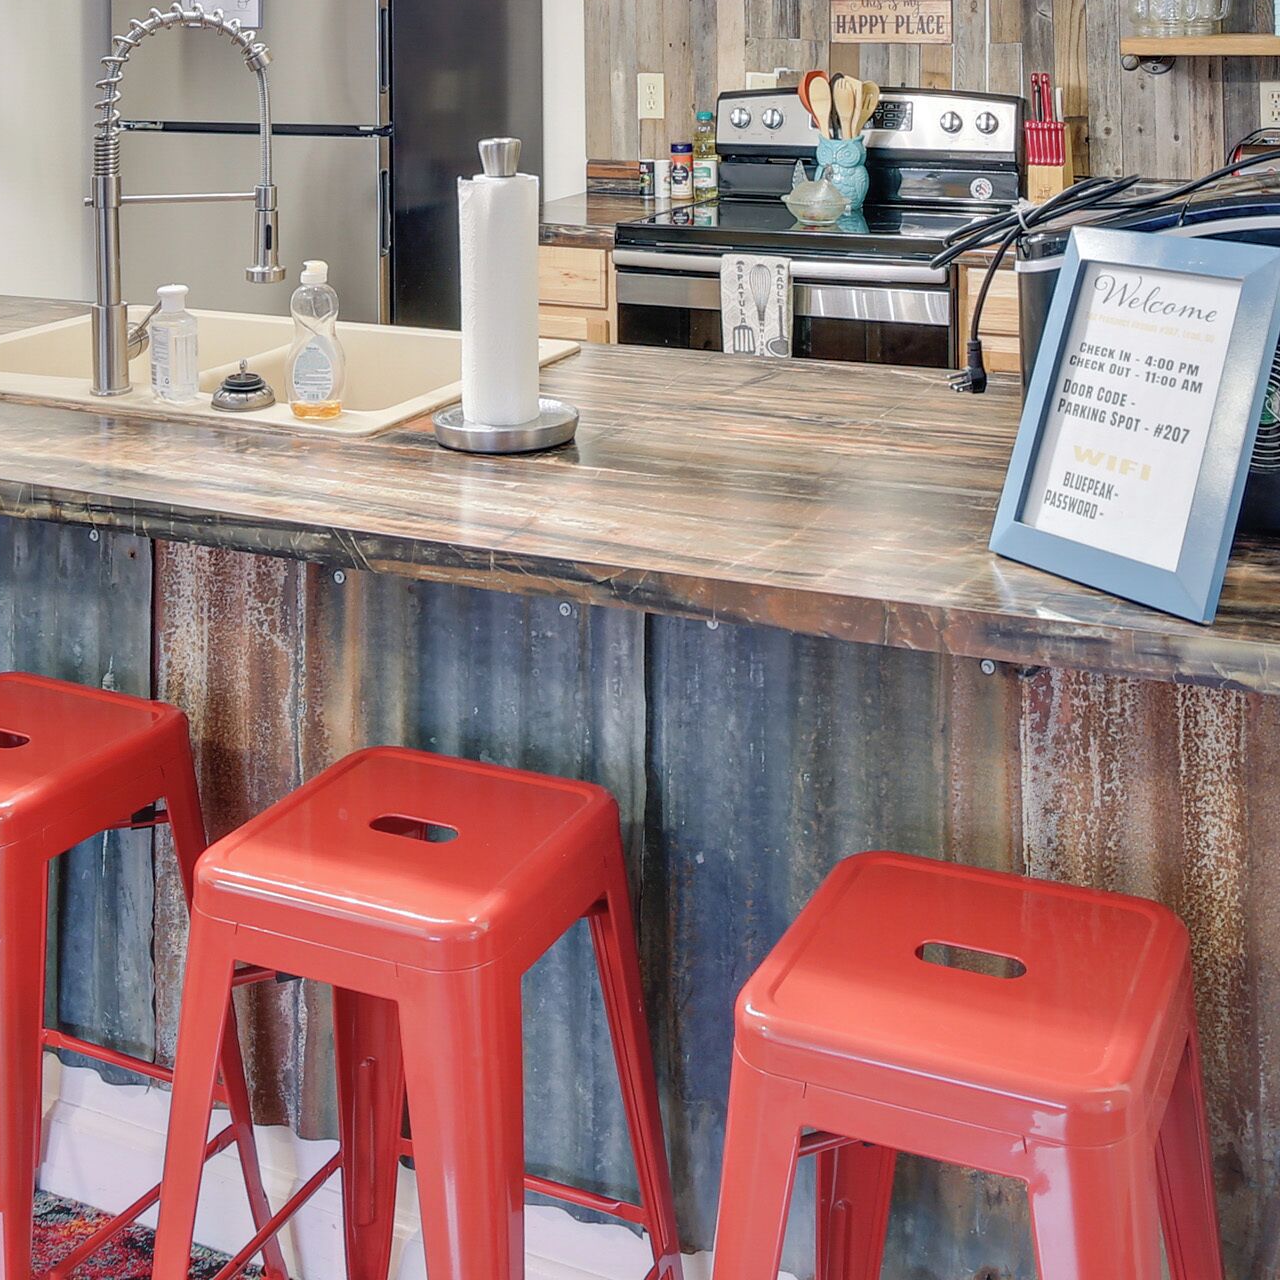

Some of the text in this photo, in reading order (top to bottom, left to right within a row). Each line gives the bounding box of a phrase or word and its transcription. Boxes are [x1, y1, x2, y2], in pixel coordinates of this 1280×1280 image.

[903, 0, 921, 18] my
[836, 15, 945, 35] HAPPY PLACE
[1094, 273, 1219, 324] Welcome
[1145, 355, 1175, 371] 4:00
[1178, 362, 1200, 376] PM
[1145, 371, 1176, 388] 11:00
[1181, 379, 1203, 393] AM
[1153, 424, 1190, 444] #207
[1073, 445, 1152, 481] WIFI
[1044, 490, 1098, 519] PASSWORD
